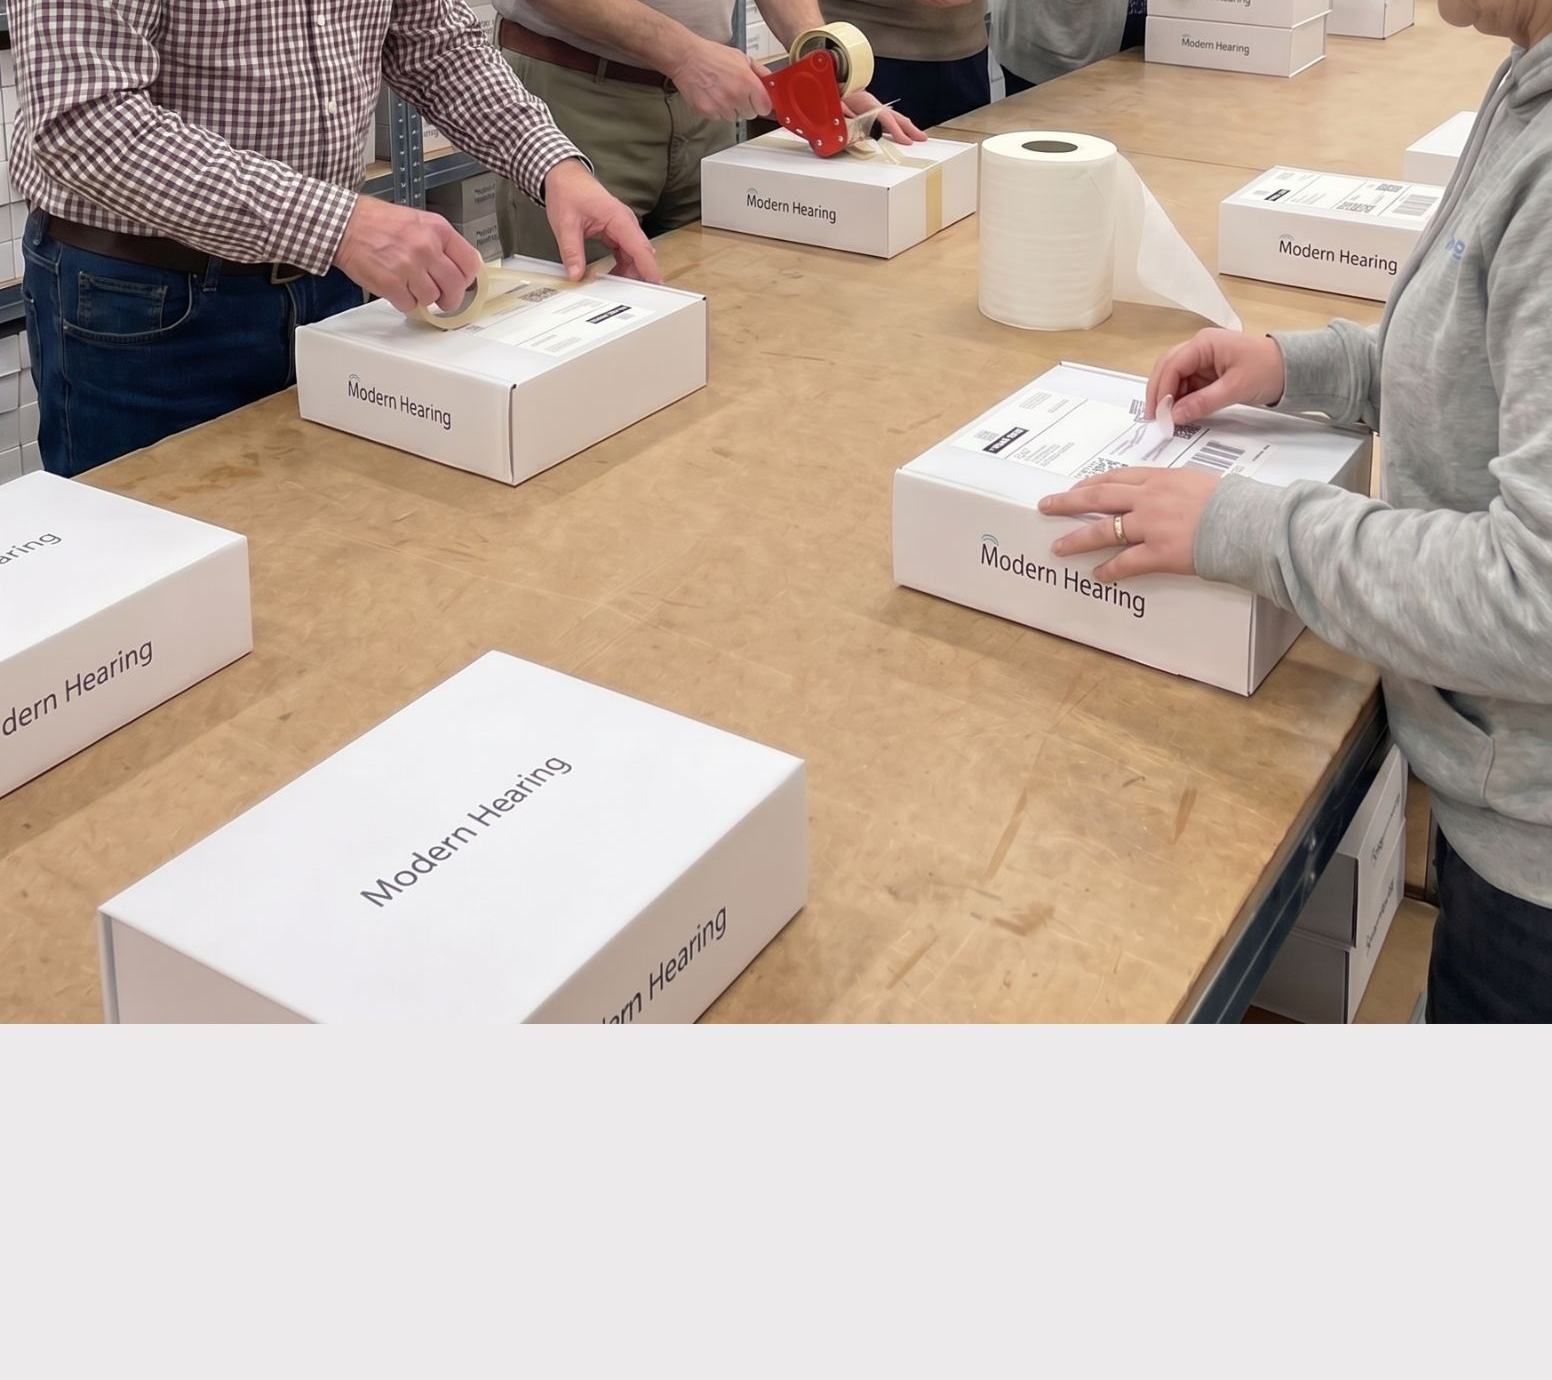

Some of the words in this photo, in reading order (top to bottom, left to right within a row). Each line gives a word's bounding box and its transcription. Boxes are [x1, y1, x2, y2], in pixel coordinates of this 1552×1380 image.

[1215, 42, 1250, 56] Hearing
[747, 194, 789, 212] Modern
[792, 201, 837, 224] Hearing
[1279, 240, 1335, 262] Modern
[1339, 249, 1398, 275] Hearing
[348, 380, 397, 410] Modern
[400, 395, 451, 430] Hearing
[0, 533, 62, 565] aring
[981, 543, 1057, 586] Modern
[1064, 567, 1145, 618] Hearing
[2, 693, 57, 736] dern
[65, 640, 153, 702] Hearing
[359, 826, 478, 908] Modern
[467, 757, 572, 827] Hearing
[649, 906, 727, 1001] Hearing
